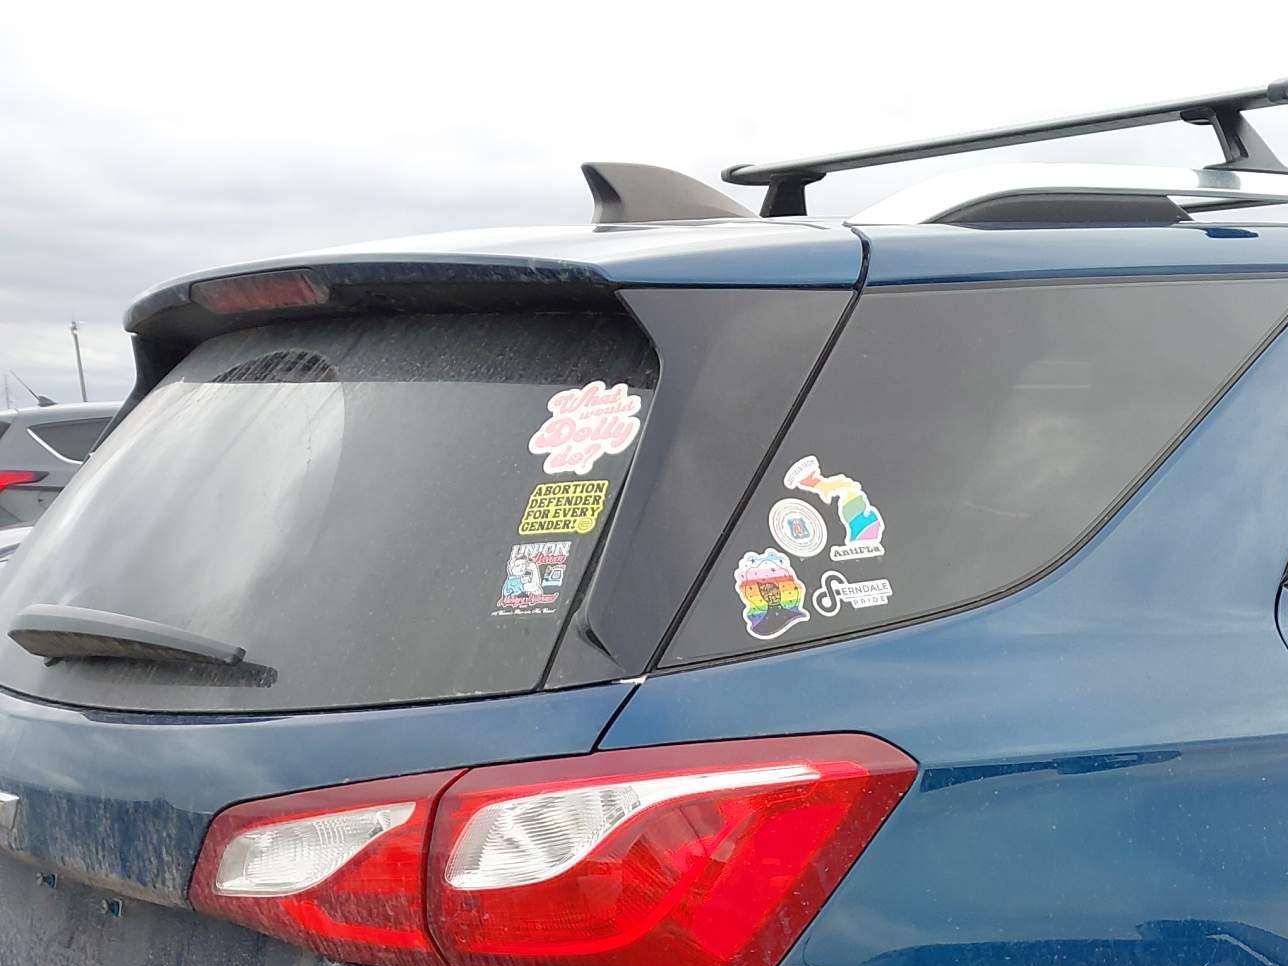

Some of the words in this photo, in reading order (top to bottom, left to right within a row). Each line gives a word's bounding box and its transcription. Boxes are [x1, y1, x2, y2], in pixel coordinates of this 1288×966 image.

[554, 385, 622, 414] What
[579, 400, 636, 420] would
[535, 416, 634, 448] Dolly
[550, 443, 602, 469] do?
[533, 482, 606, 497] ABORTION
[529, 495, 602, 509] DEFENDER
[524, 508, 551, 521] FOR
[552, 506, 601, 519] EVERY
[521, 519, 577, 532] GENDER!
[852, 595, 886, 606] PRIDE
